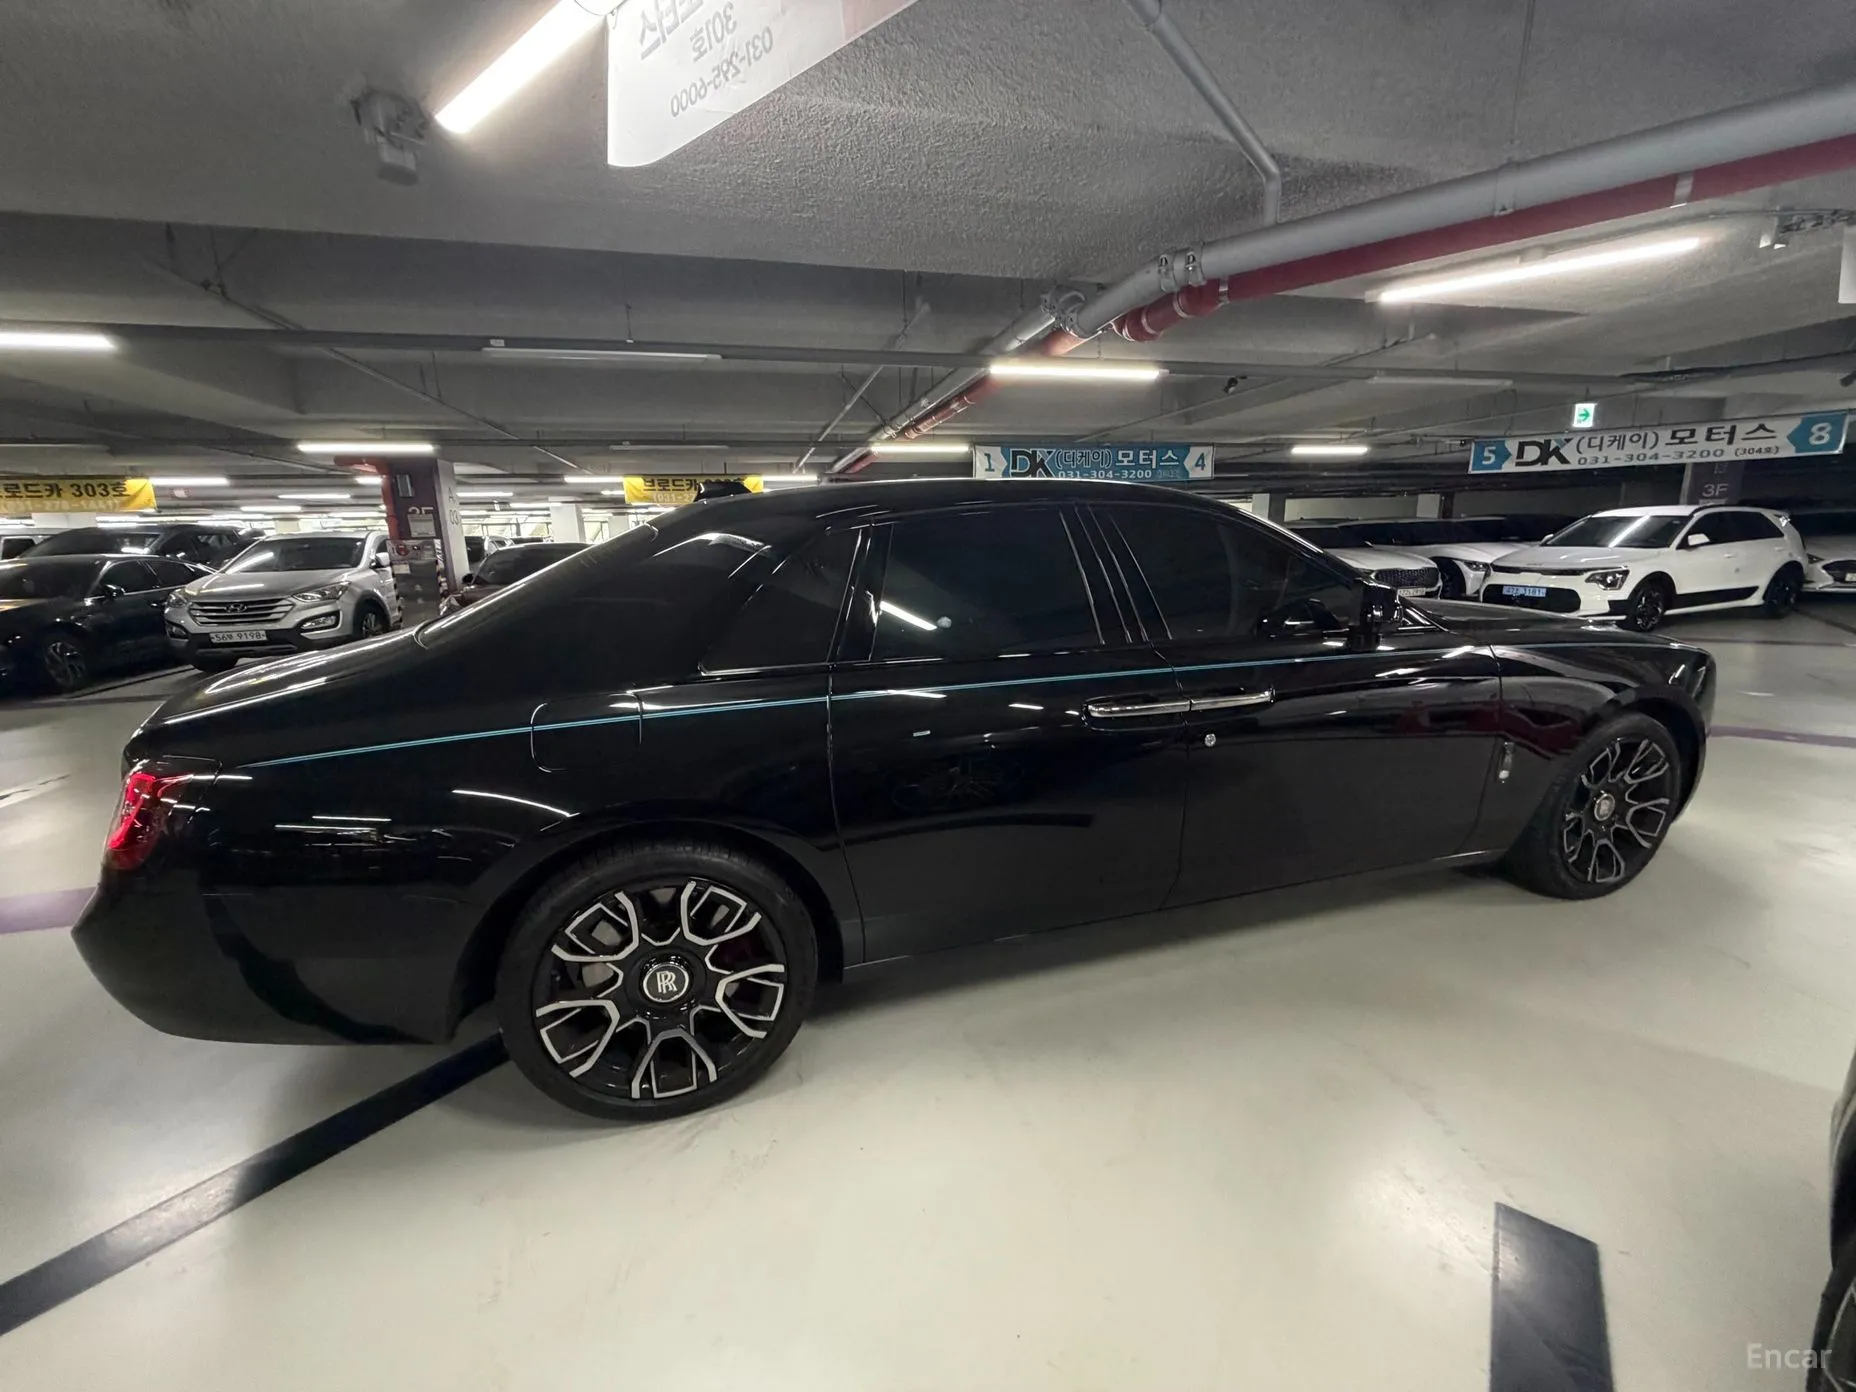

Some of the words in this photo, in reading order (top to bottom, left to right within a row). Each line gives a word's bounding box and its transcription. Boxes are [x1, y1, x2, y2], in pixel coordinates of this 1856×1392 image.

[1809, 422, 1832, 445] 8
[1515, 438, 1573, 467] DK
[1576, 431, 1659, 455] (디케이)
[1665, 423, 1777, 445] 모터스
[984, 453, 995, 472] 1
[1010, 448, 1056, 478] DK
[1116, 450, 1179, 469] 모터스
[1195, 453, 1206, 471] 4
[1482, 446, 1496, 465] 5
[1577, 449, 1724, 465] 031-304-3200
[1058, 470, 1152, 479] 031-304-3200
[0, 482, 62, 498] 로드카
[70, 482, 130, 497] 303호
[1702, 483, 1729, 497] 3F
